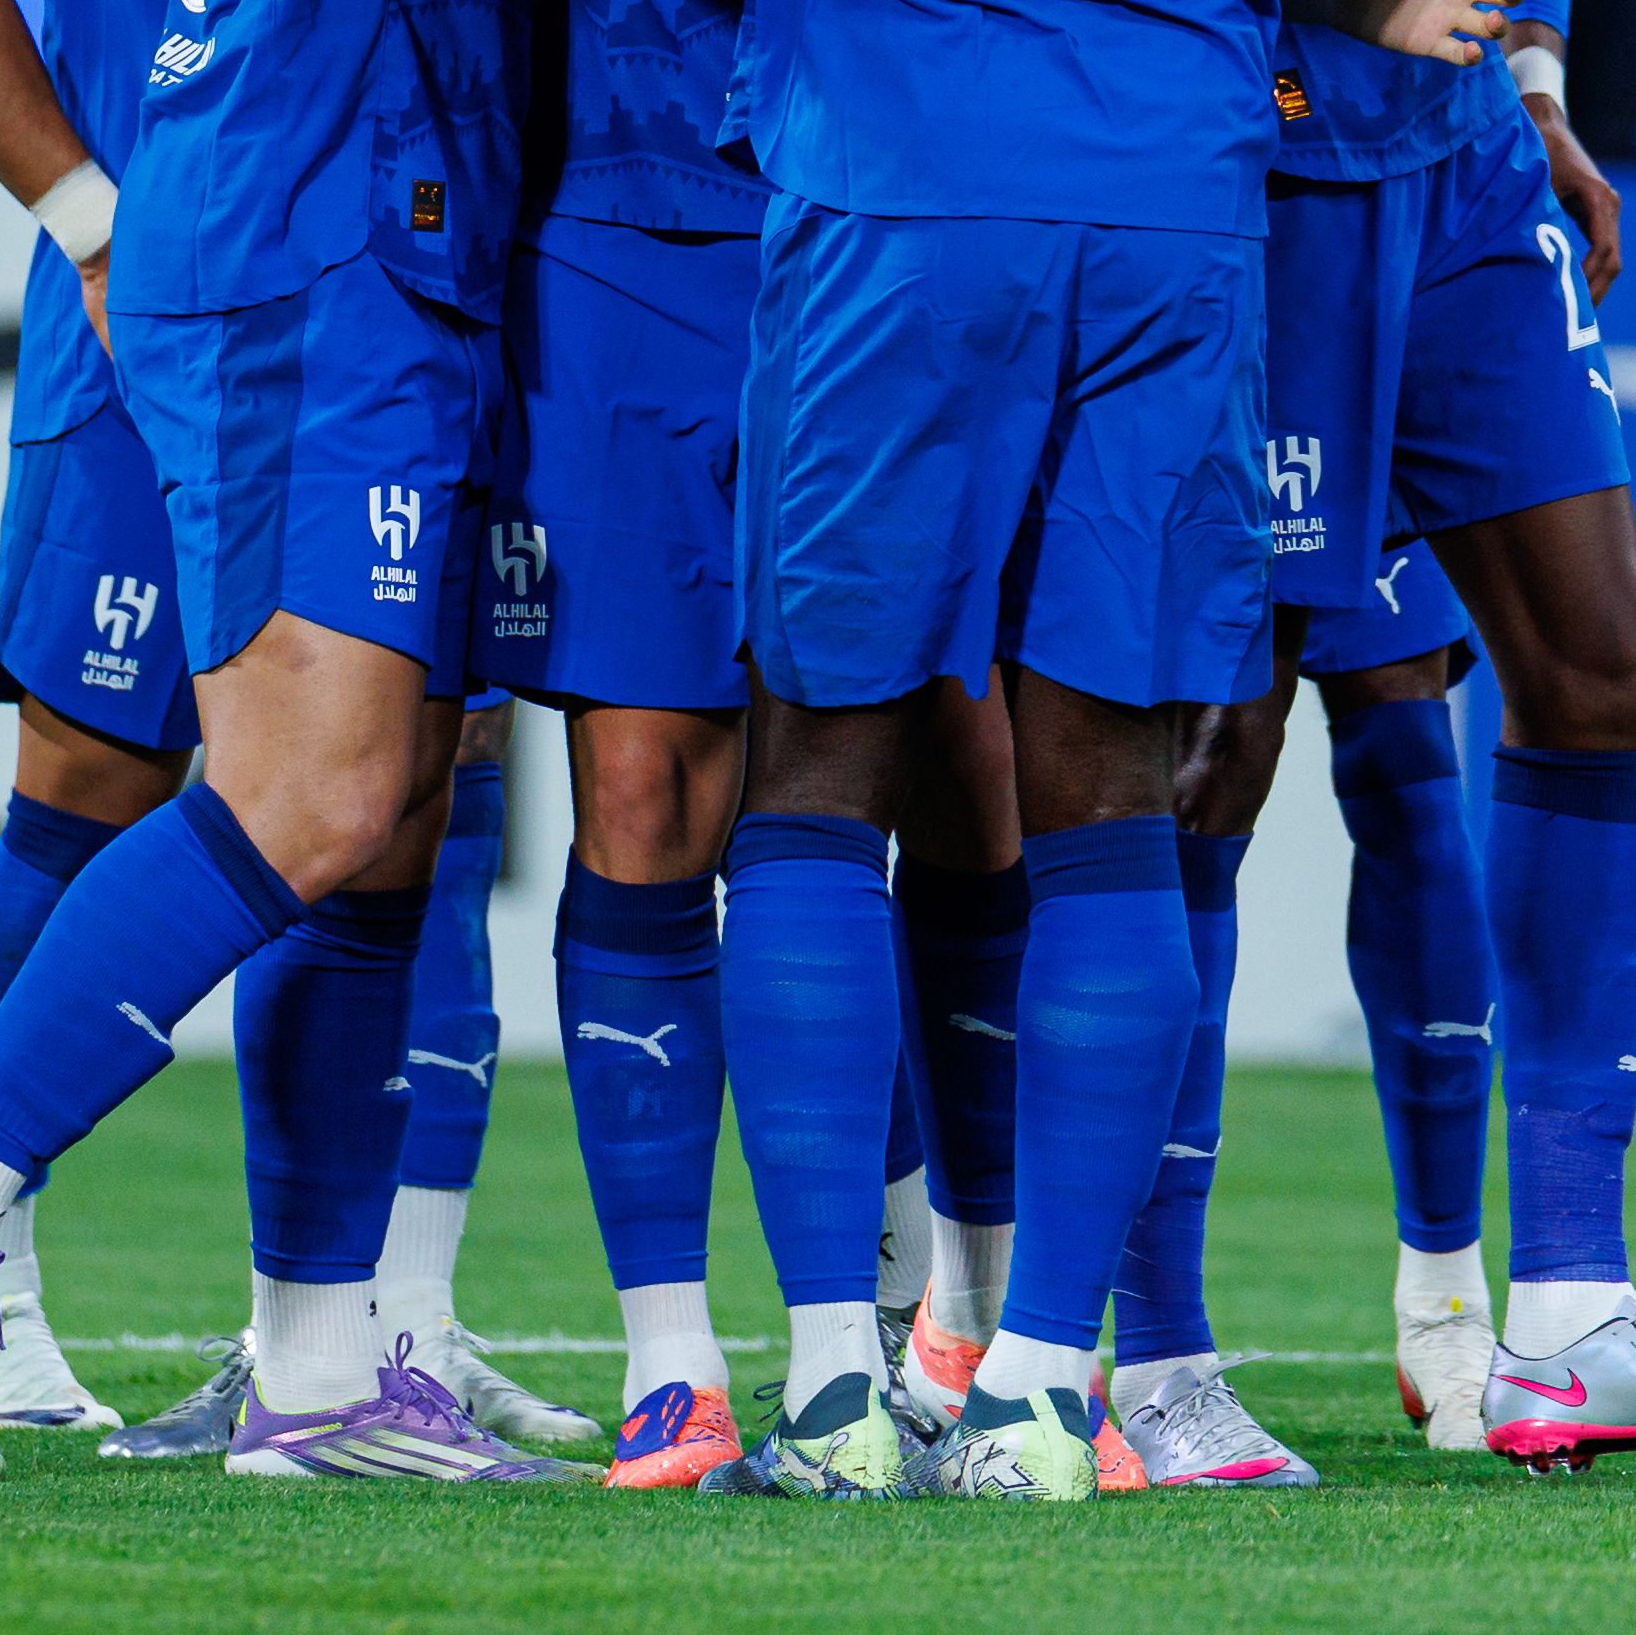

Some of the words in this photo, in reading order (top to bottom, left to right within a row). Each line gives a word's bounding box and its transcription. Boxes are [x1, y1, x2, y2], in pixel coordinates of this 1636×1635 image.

[1536, 223, 1601, 352] 2
[1270, 517, 1327, 534] ALHILAL
[371, 565, 418, 585] ALHILAL
[493, 603, 550, 619] ALHILAL
[83, 649, 140, 676] ALHILAL
